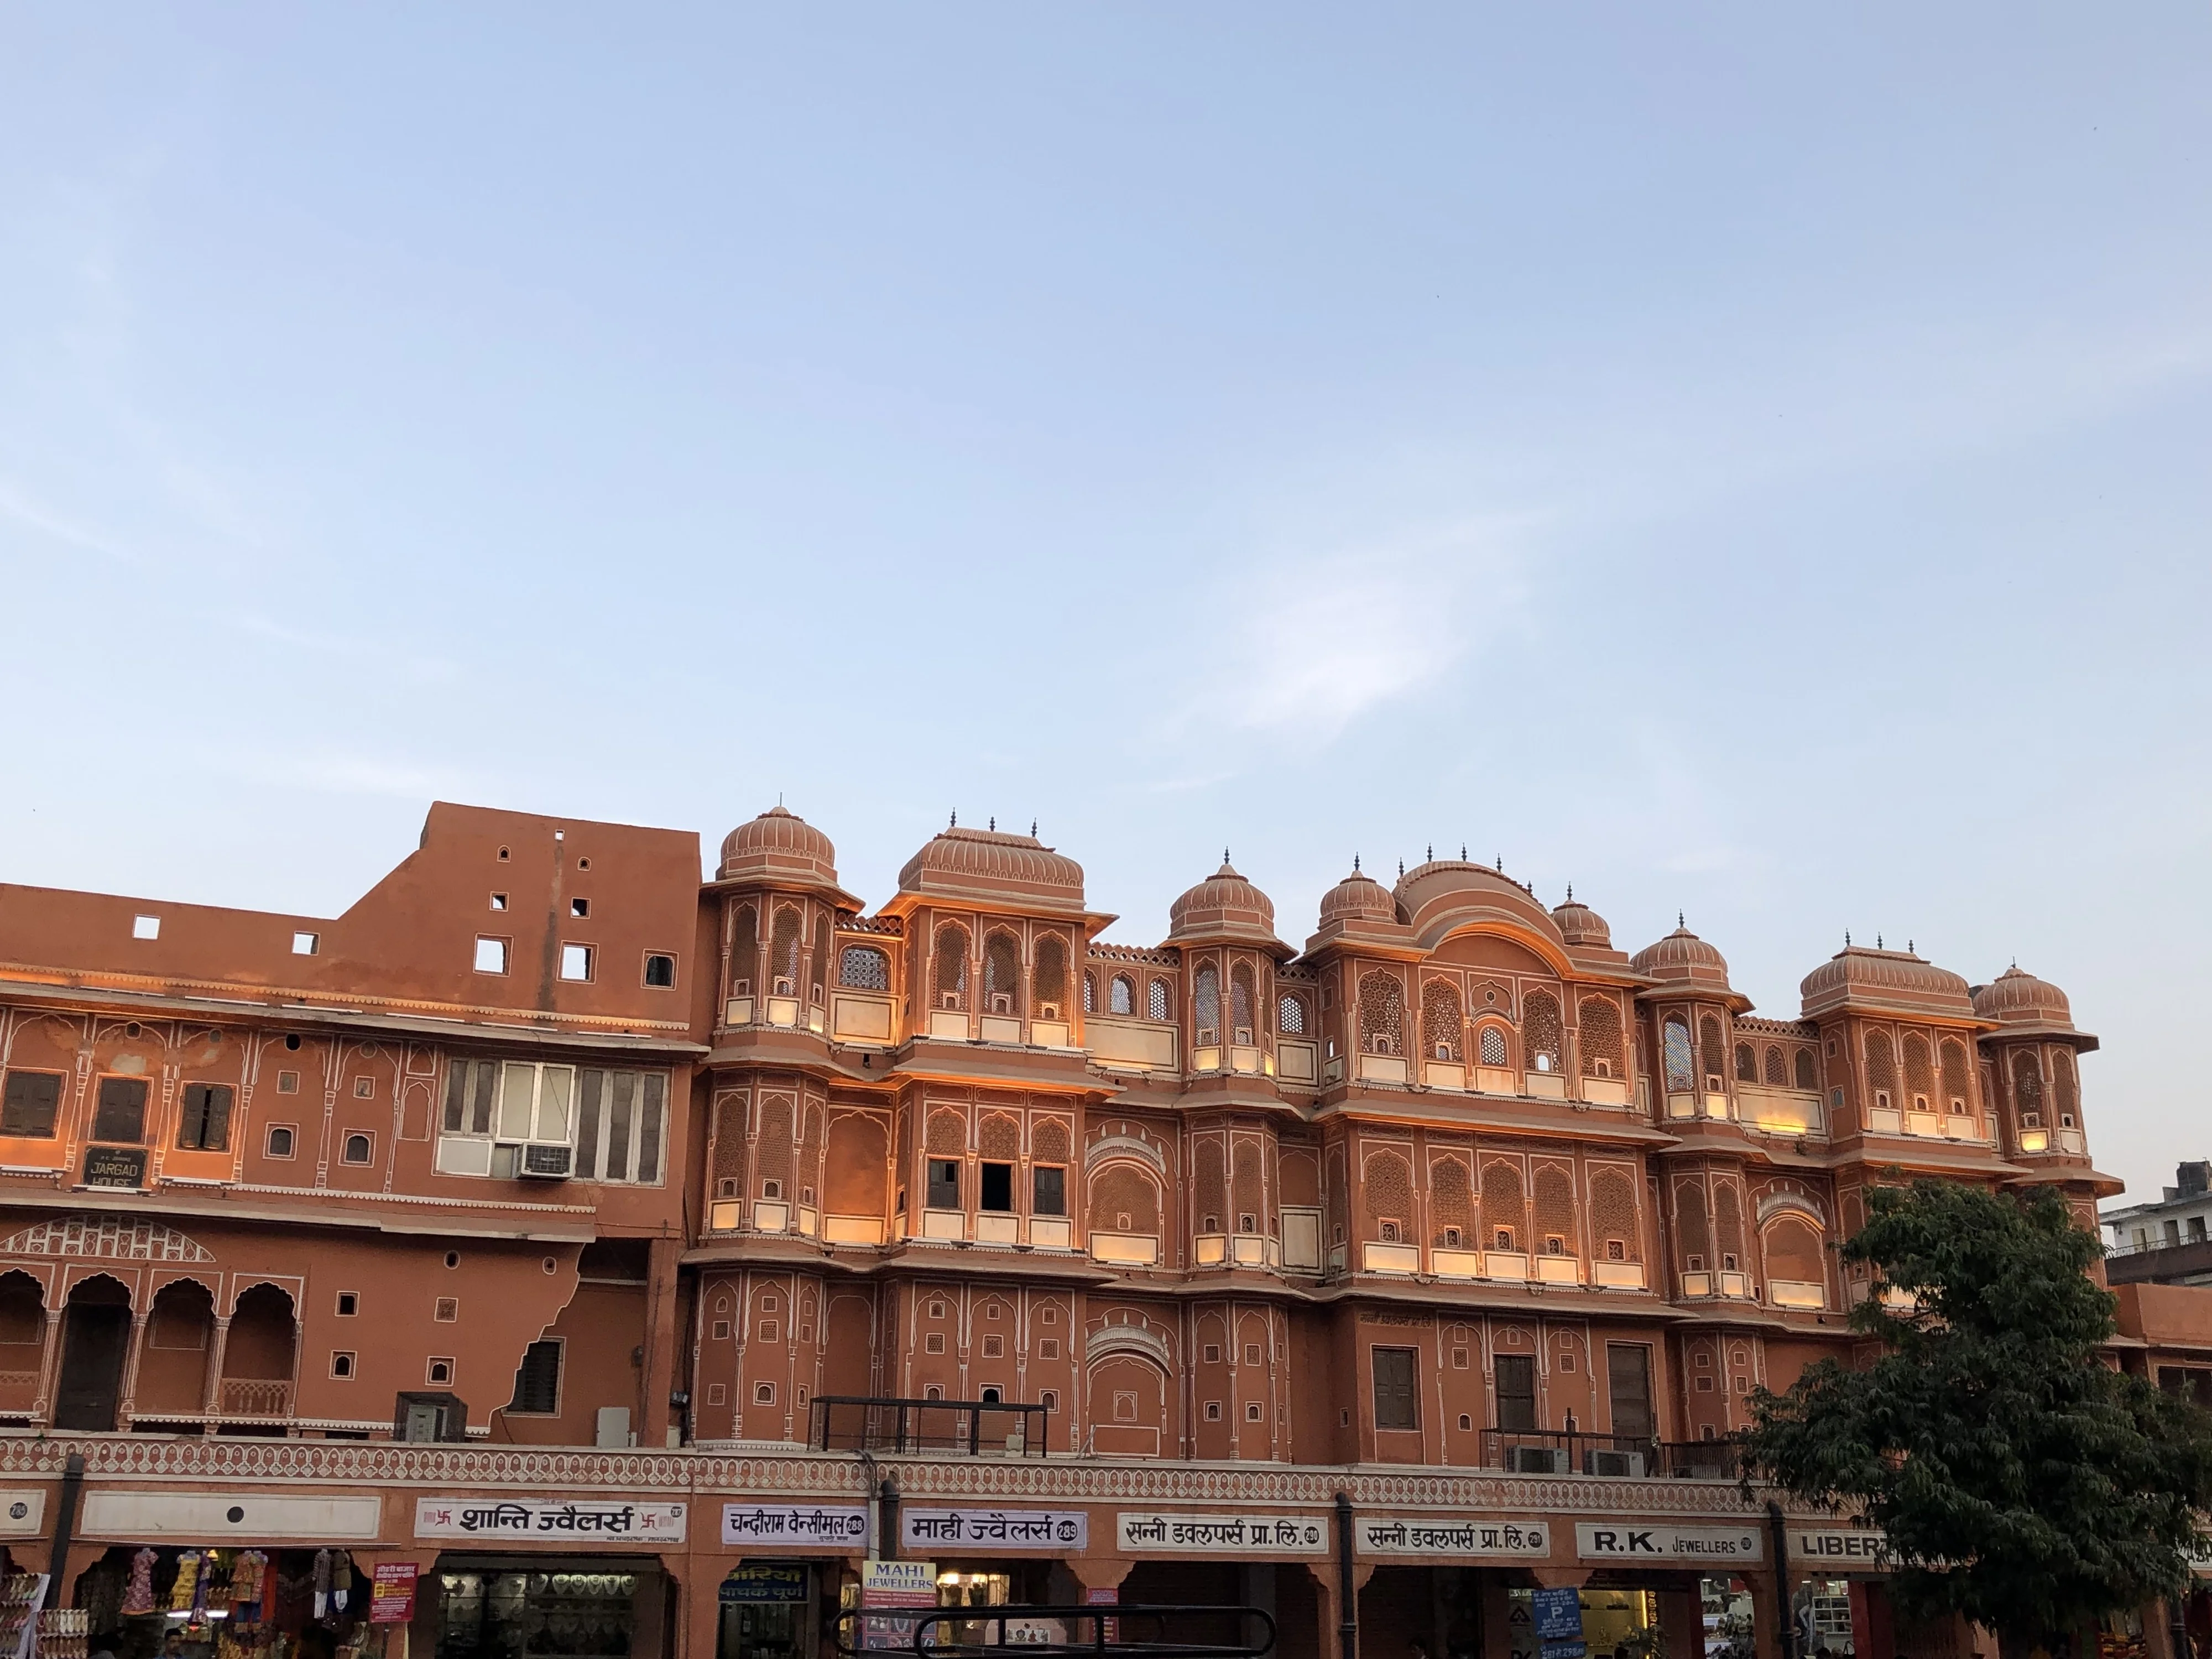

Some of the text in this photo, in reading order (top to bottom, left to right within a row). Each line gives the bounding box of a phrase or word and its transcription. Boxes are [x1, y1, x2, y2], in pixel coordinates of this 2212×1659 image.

[91, 1162, 138, 1176] JARGAD
[459, 1504, 634, 1533] शान्ति ज्वैलर्स
[731, 1510, 847, 1536] चन्दीराम वेन्सीमल
[847, 1520, 863, 1531] 288
[912, 1513, 1053, 1541] माही ज्वैलर्स
[1057, 1524, 1078, 1538] 289
[1126, 1517, 1167, 1544] सन्नी
[1172, 1520, 1246, 1545] डवलपर्स
[1305, 1530, 1318, 1540] 290
[1368, 1522, 1407, 1548] सन्नी
[1411, 1524, 1475, 1550] डवलपर्स
[1594, 1531, 1663, 1553] R.K.
[875, 1564, 924, 1577] MAHI
[867, 1578, 933, 1589] JEWELLERS
[1551, 1606, 1563, 1619] P
